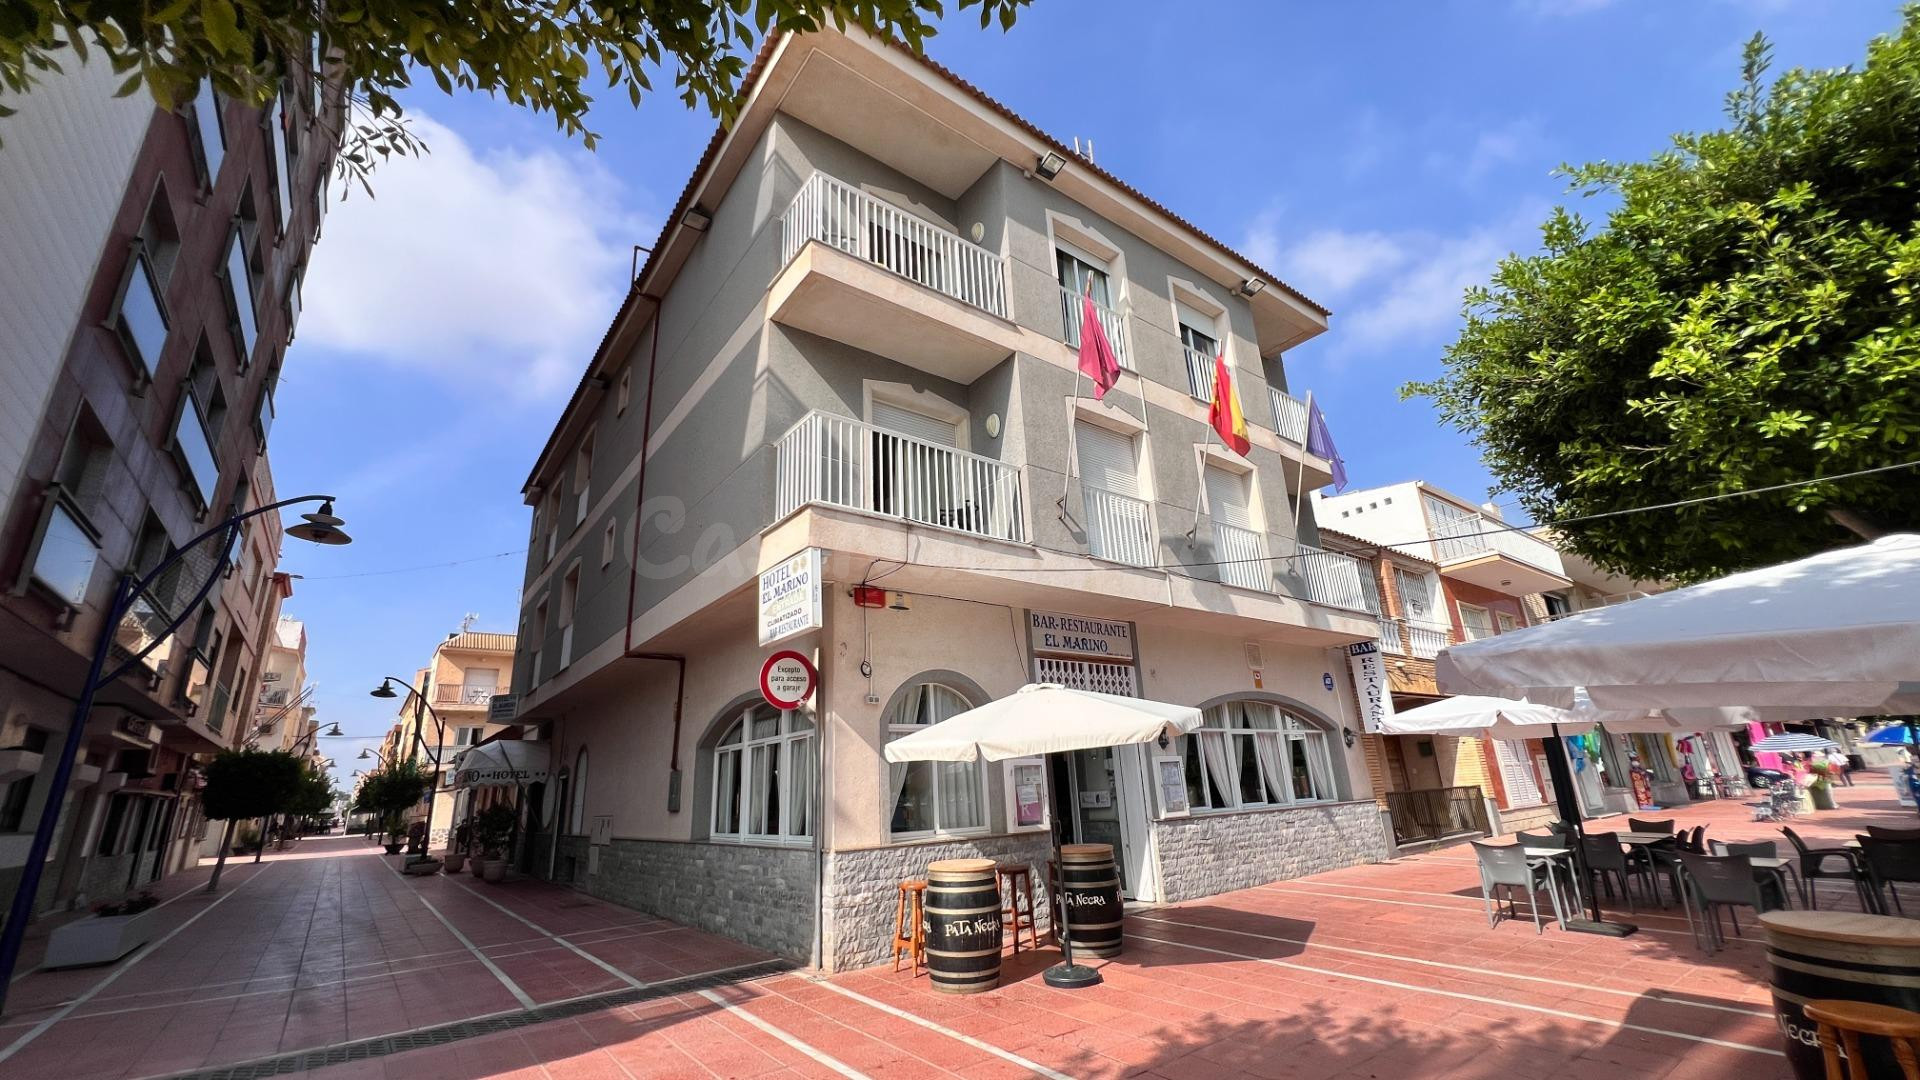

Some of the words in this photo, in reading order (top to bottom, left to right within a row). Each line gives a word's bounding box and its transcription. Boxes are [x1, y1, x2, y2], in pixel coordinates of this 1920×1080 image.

[763, 564, 792, 591] HOTEL
[762, 590, 773, 604] EL
[773, 572, 808, 599] MARINO
[767, 607, 802, 627] CLIMATIZADO
[1032, 613, 1127, 638] BAR-RESTAURANTE
[1045, 633, 1059, 647] EL
[1063, 635, 1108, 653] MARINO
[1351, 643, 1376, 654] BAR
[777, 665, 801, 674] Excepto
[783, 685, 801, 693] garaje
[1360, 656, 1384, 730] RESTAURANT
[492, 769, 530, 780] HOTEL
[944, 919, 973, 937] PATA
